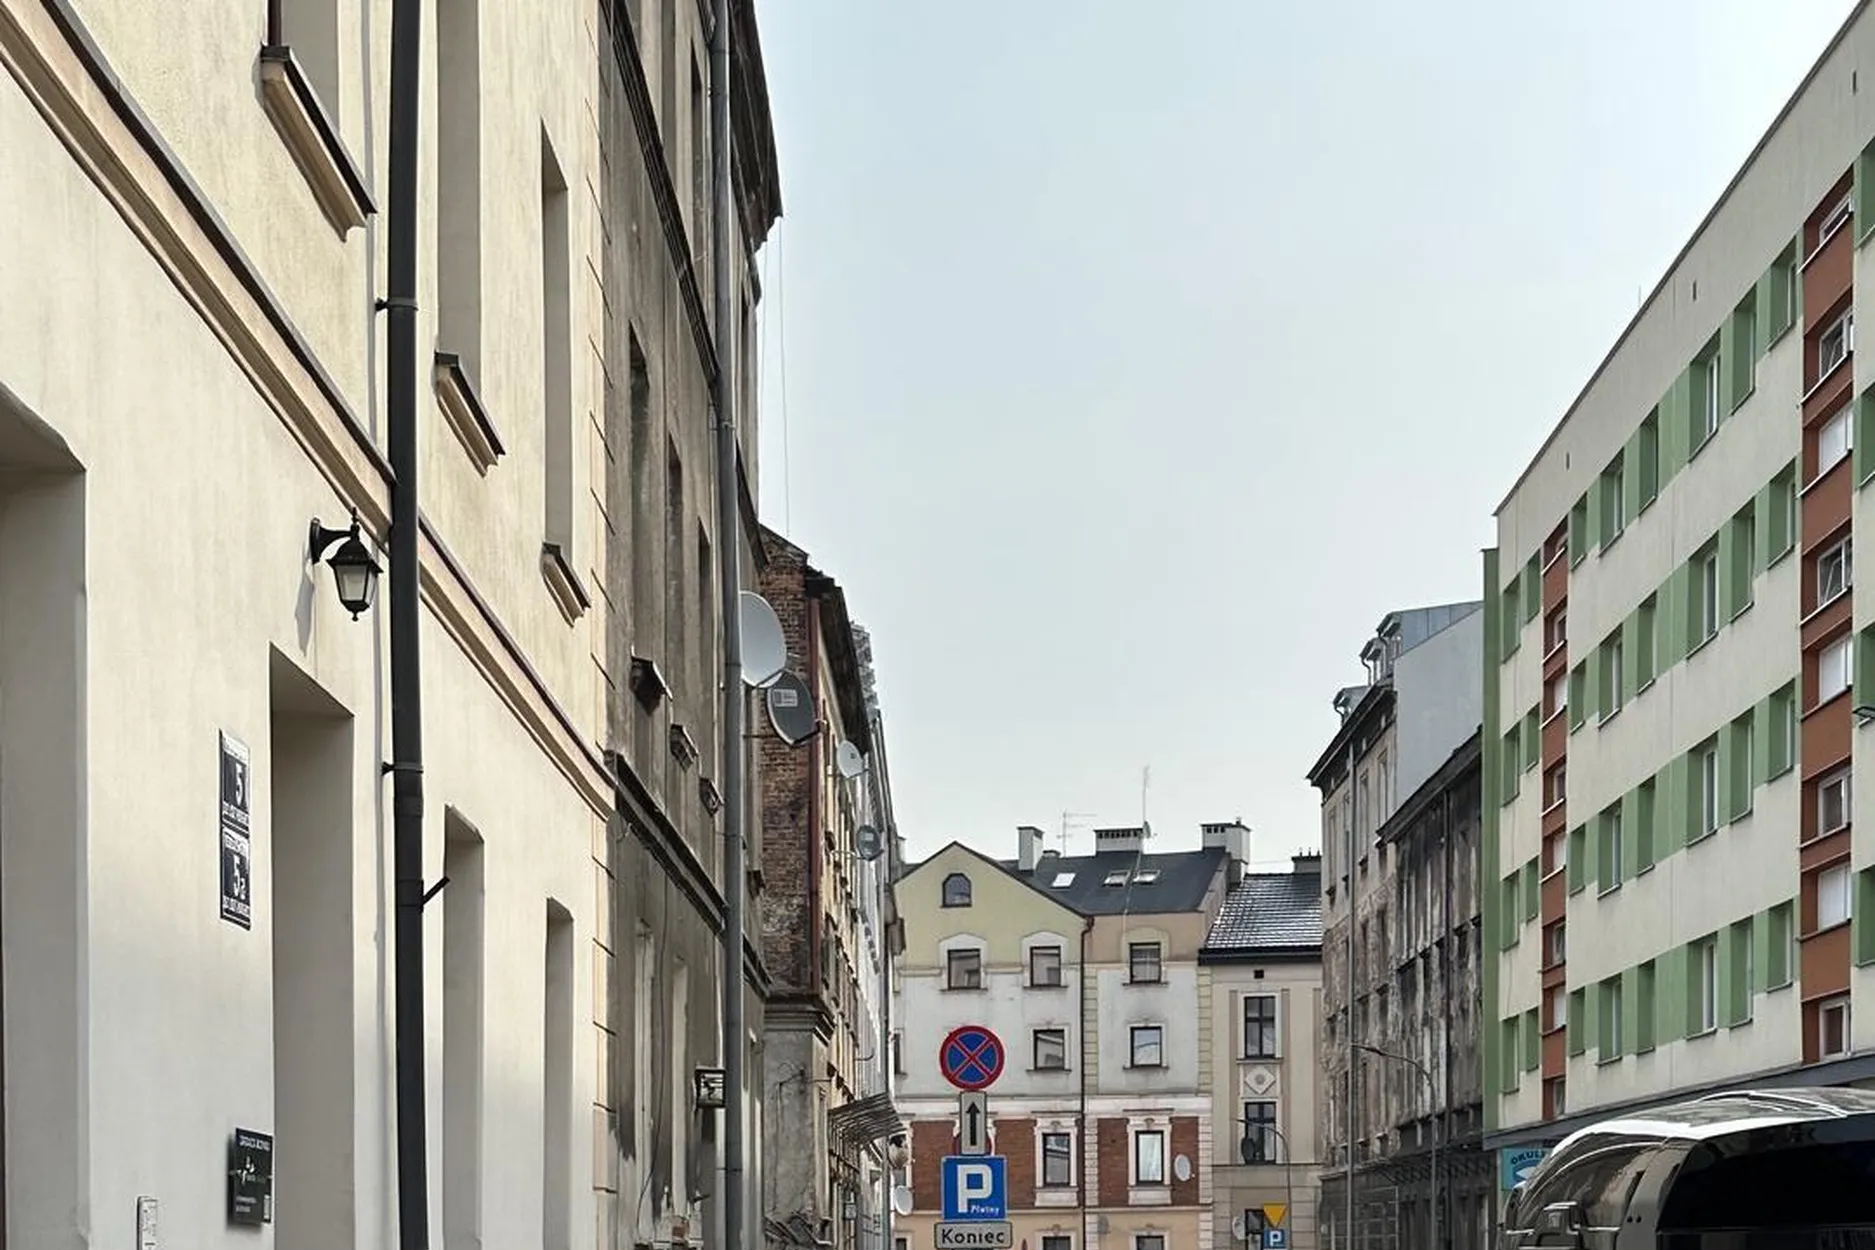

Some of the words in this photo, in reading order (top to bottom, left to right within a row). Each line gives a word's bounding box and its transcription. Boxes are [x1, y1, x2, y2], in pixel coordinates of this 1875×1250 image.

[957, 1164, 993, 1213] P
[941, 1228, 1005, 1244] Koniec
[1270, 1231, 1282, 1247] P
